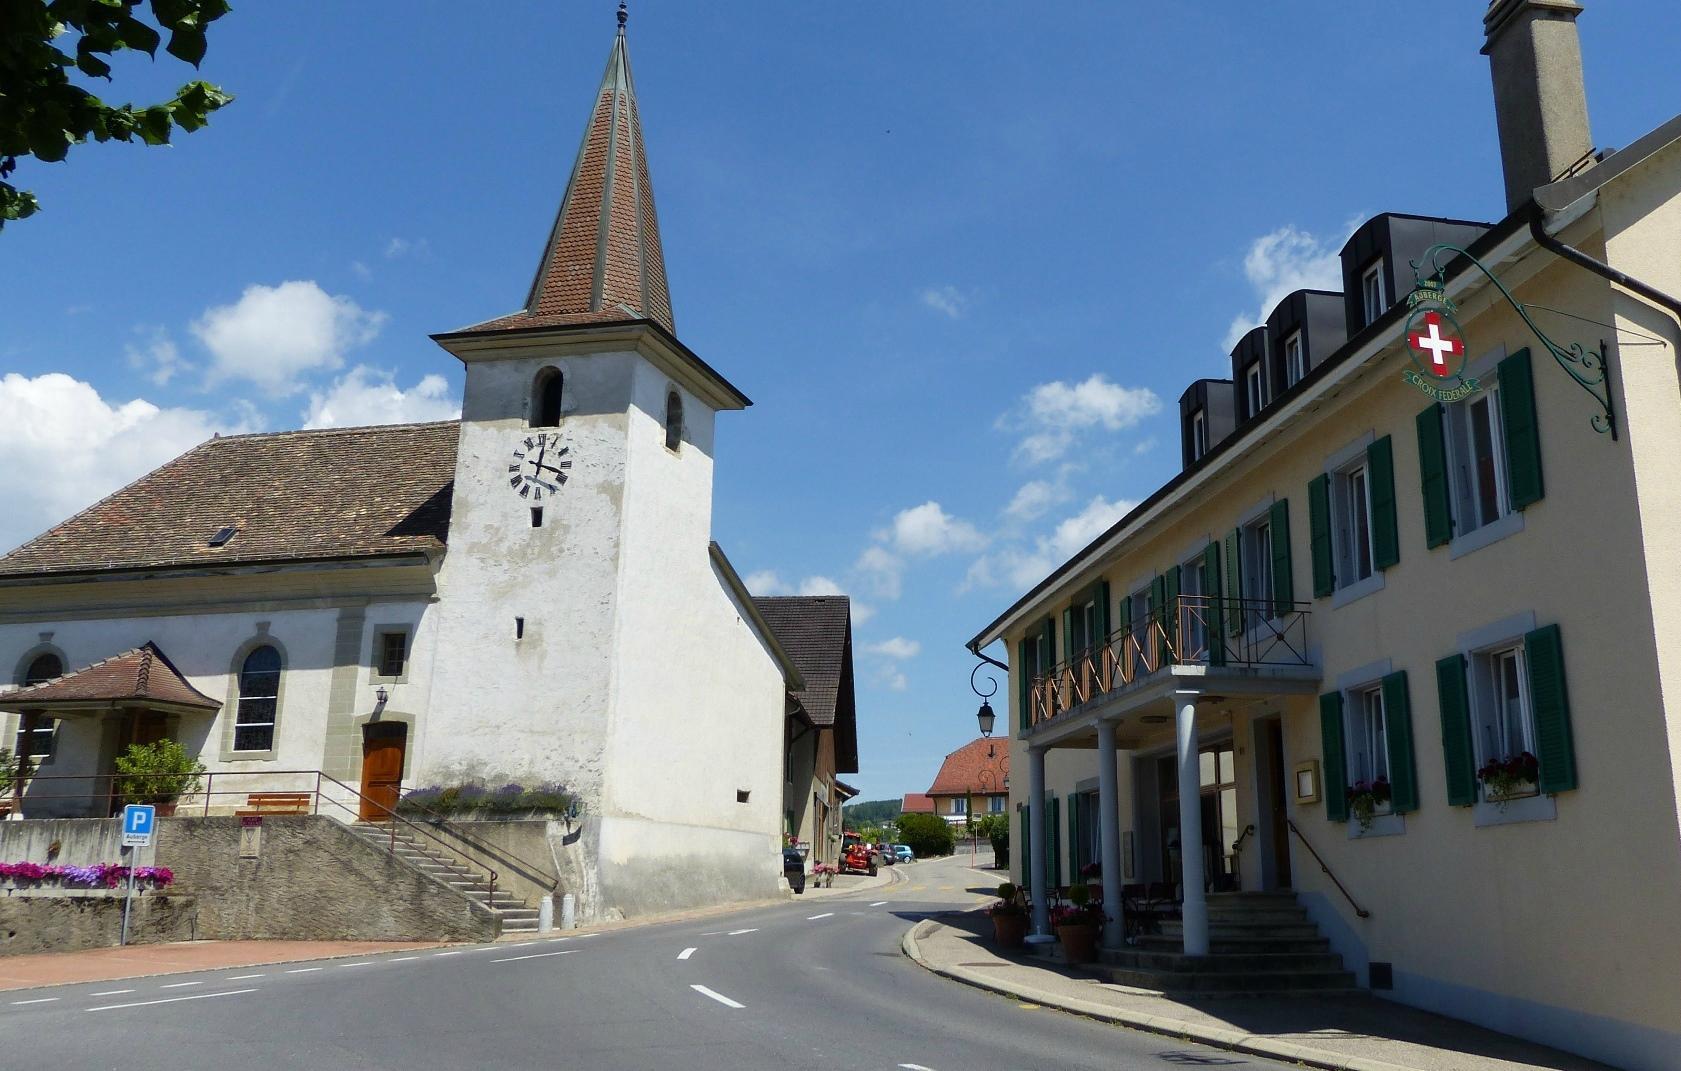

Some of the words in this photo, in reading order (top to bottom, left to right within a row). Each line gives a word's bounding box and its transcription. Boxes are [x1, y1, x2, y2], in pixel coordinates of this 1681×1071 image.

[1414, 291, 1446, 304] AUBERGE
[1412, 375, 1437, 398] CROIX
[1438, 381, 1472, 401] FEDERALE
[132, 811, 147, 831] P
